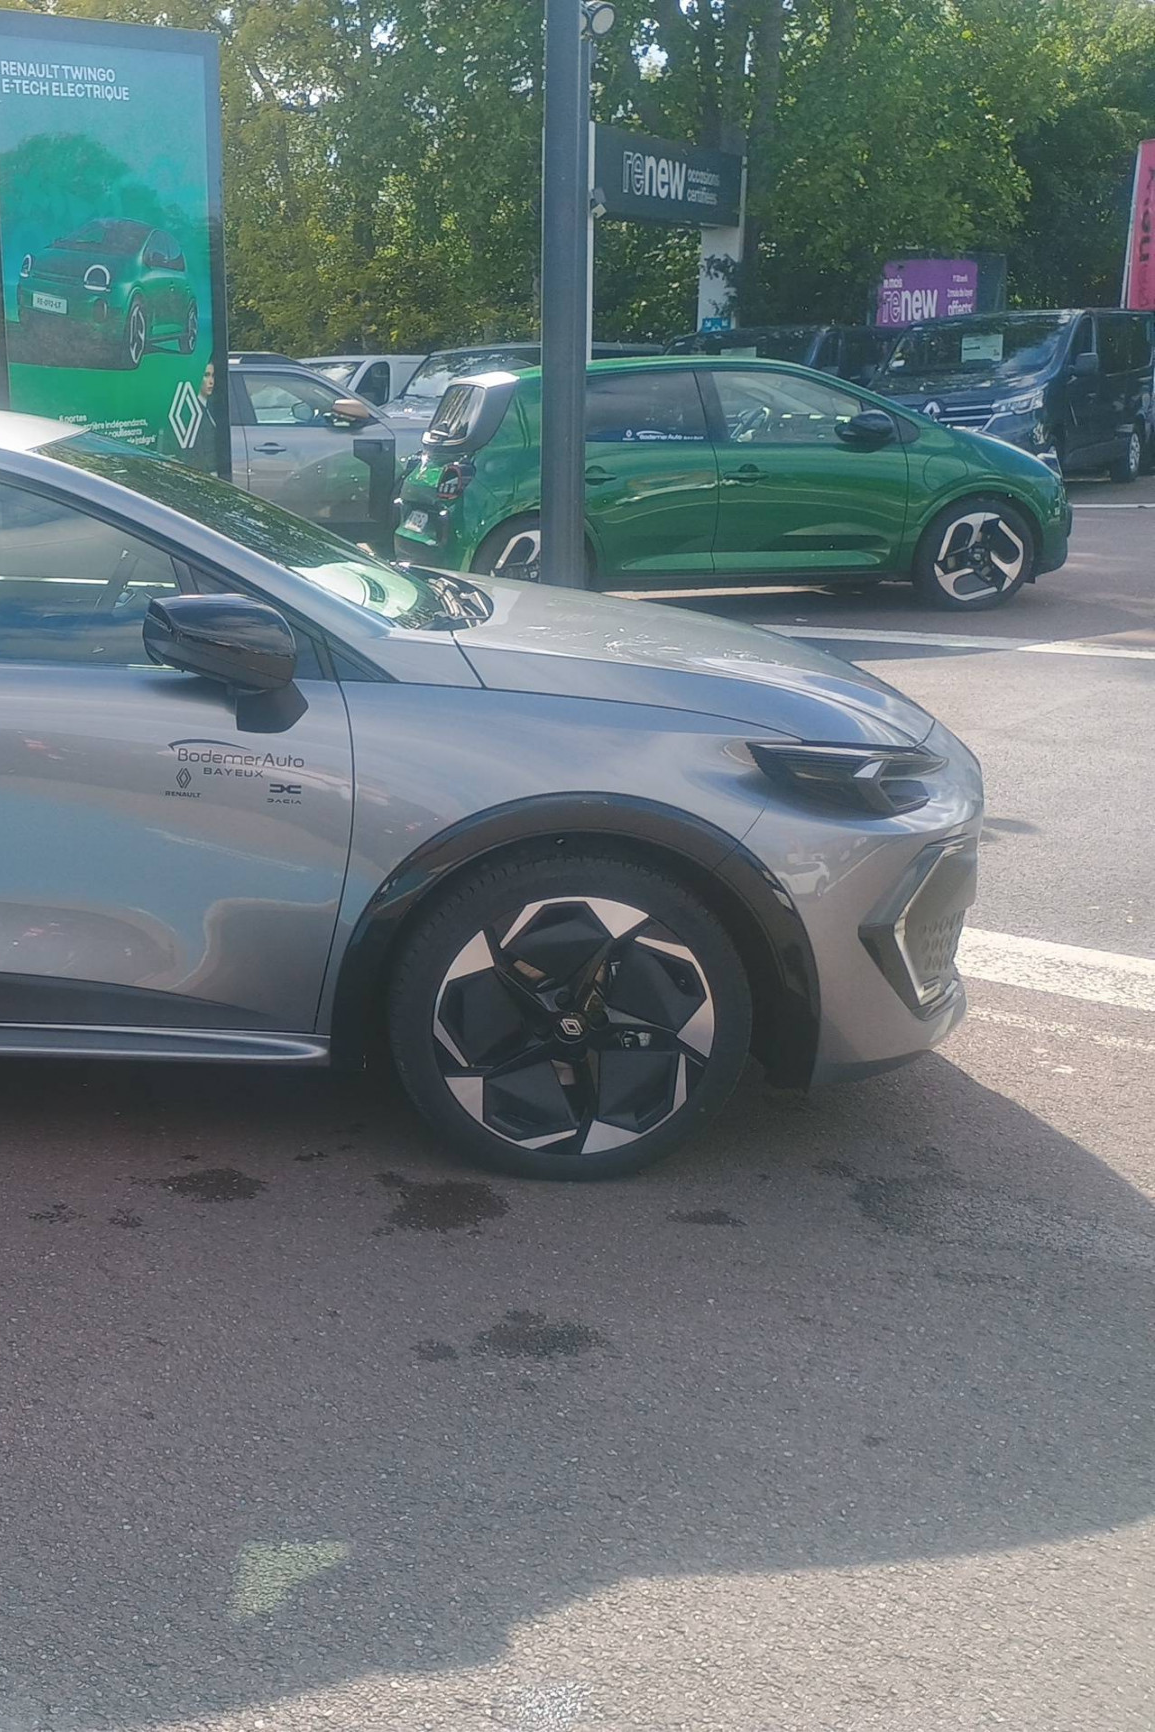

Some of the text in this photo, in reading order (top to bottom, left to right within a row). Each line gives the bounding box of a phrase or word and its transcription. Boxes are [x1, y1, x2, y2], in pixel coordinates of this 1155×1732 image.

[0, 60, 115, 83] RENAULT TWINGO
[1, 78, 130, 101] E-TECH ELECTRIQUE
[622, 150, 686, 201] renew
[882, 289, 938, 323] renew
[203, 767, 264, 778] BAYEUX
[165, 790, 201, 798] RENAULT
